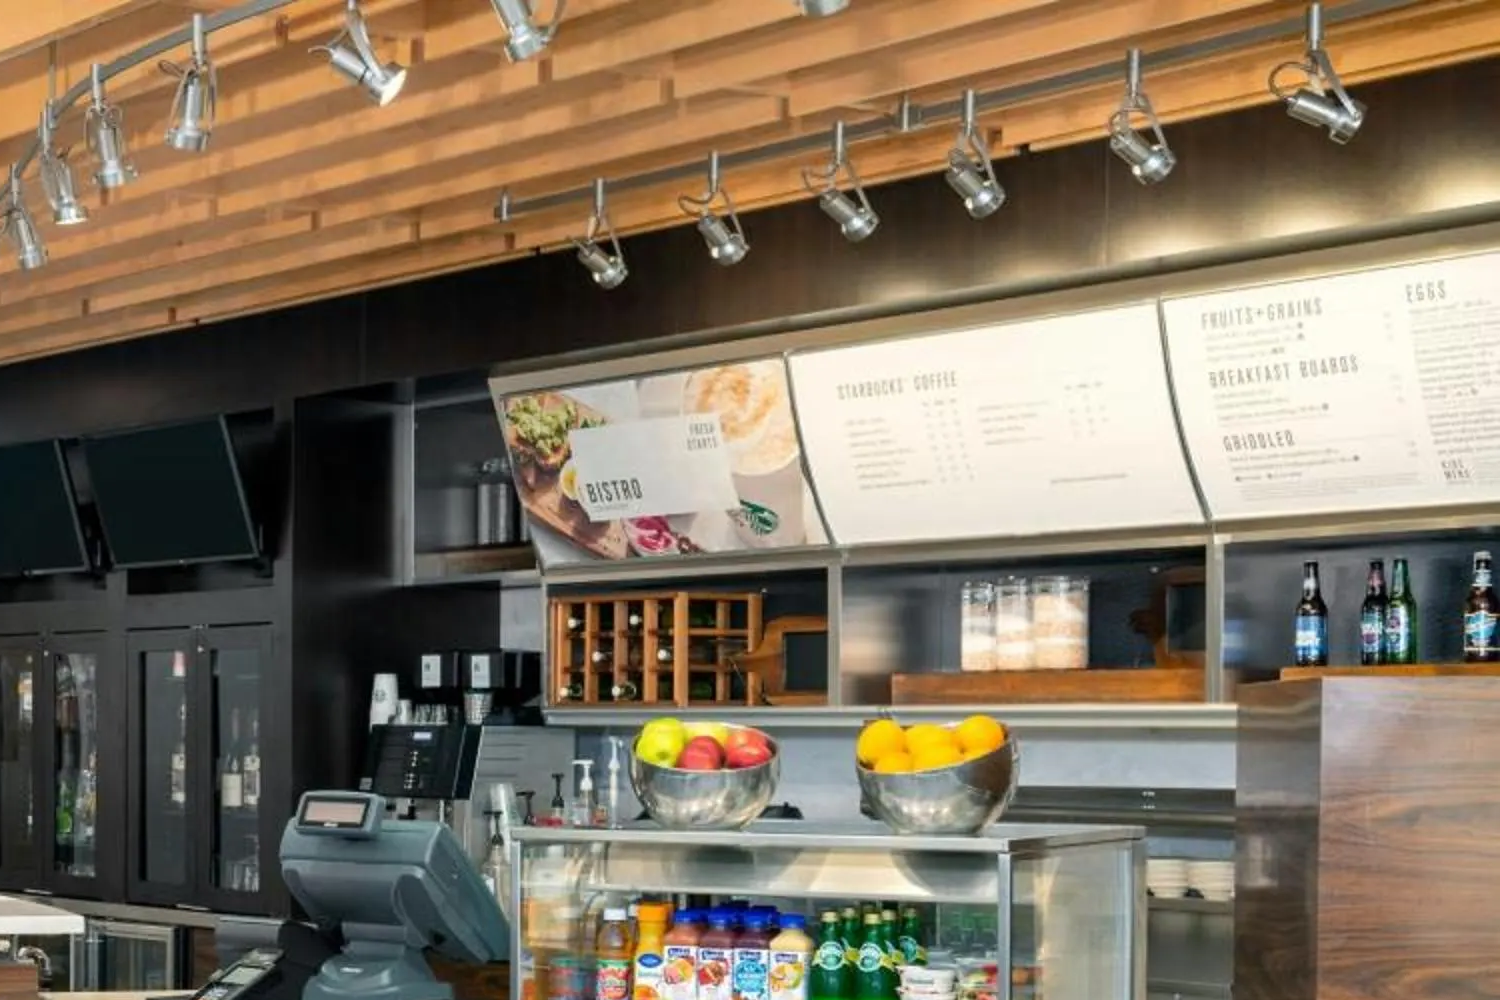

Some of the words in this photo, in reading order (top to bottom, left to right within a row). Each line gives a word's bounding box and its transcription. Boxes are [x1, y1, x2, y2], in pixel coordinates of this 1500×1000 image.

[1405, 279, 1446, 303] EGGS
[913, 370, 957, 391] COFFEE
[1208, 362, 1290, 388] BREAKFAST
[1299, 354, 1359, 378] BOARDS
[1222, 429, 1296, 452] GRIDDLED
[586, 477, 643, 503] BISTRO
